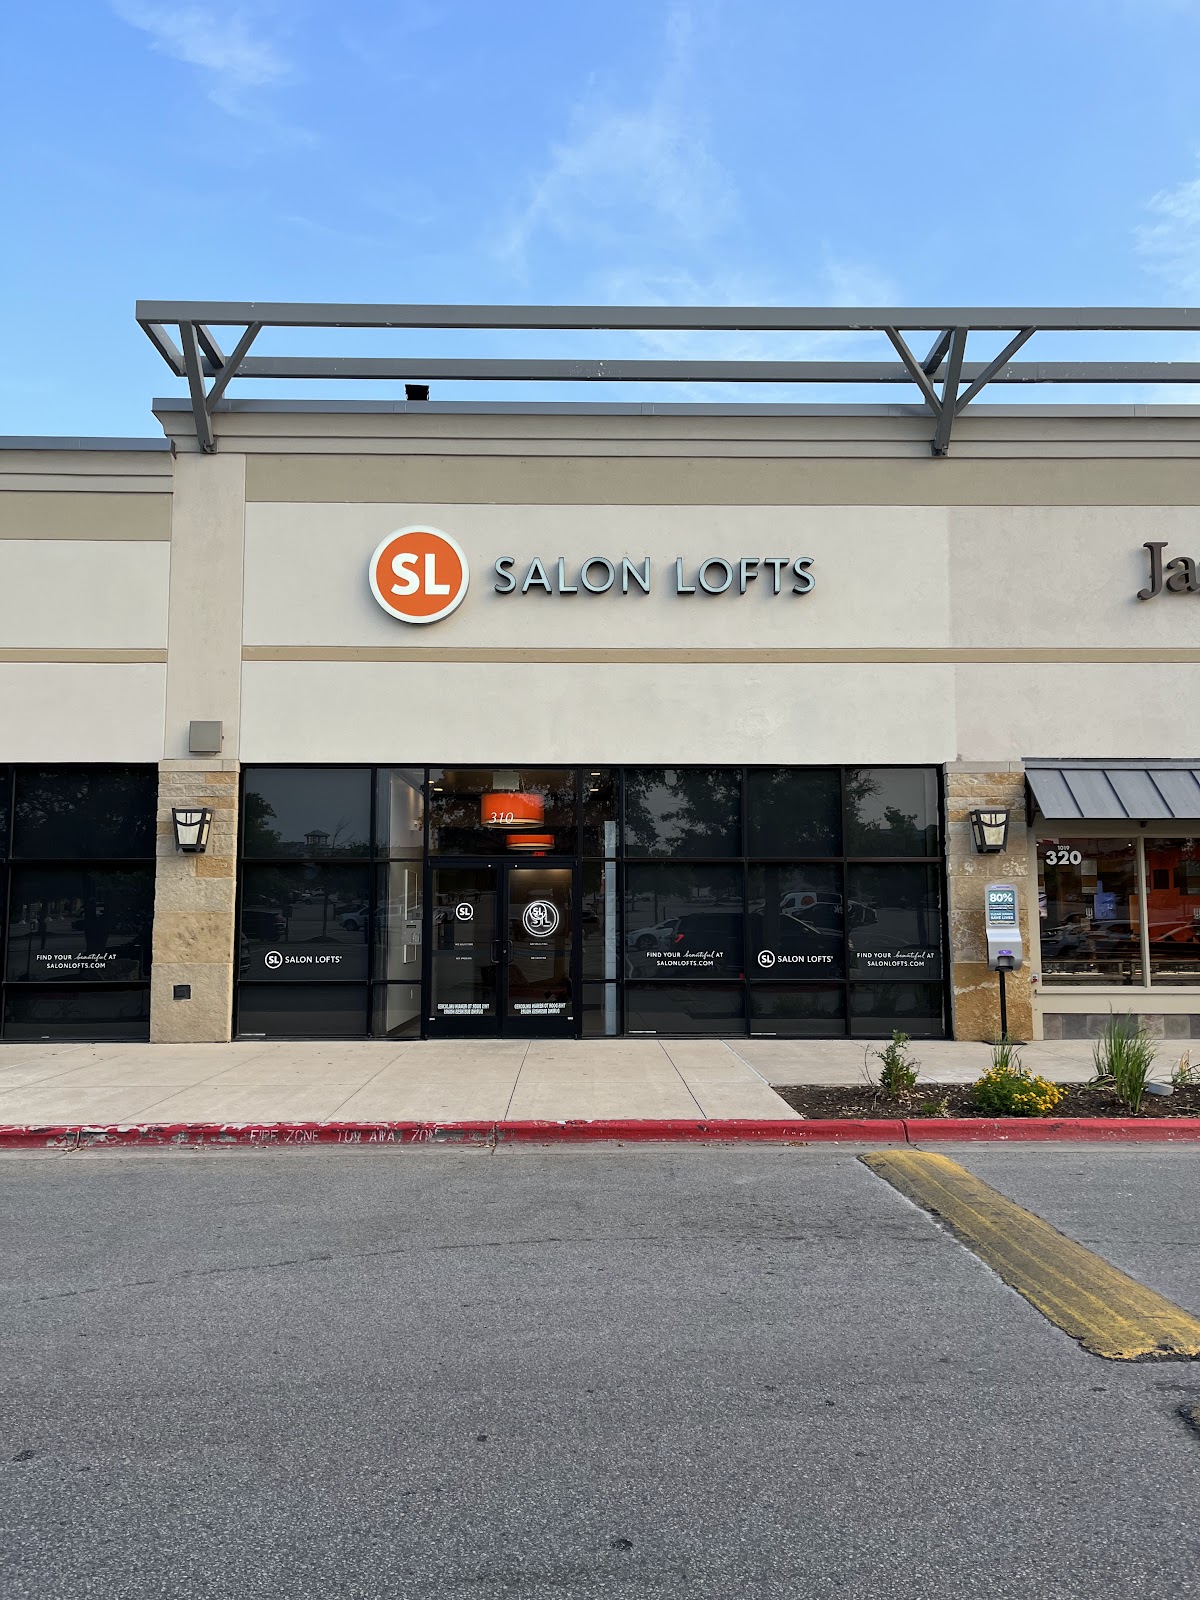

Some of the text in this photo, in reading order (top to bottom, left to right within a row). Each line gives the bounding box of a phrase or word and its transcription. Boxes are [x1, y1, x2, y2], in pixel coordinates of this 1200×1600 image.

[391, 552, 450, 595] SL
[494, 557, 815, 595] SALON LOFTS
[1137, 542, 1200, 600] Ja
[489, 811, 514, 825] 310
[1046, 851, 1081, 865] 320
[989, 893, 1013, 903] 80%
[459, 907, 471, 916] SL
[74, 952, 108, 962] beautiful
[268, 955, 280, 964] SL
[285, 955, 313, 964] SALON
[683, 950, 715, 960] beautiful
[761, 954, 772, 963] SL
[777, 955, 804, 963] SALON
[893, 950, 926, 960] beautiful
[250, 1129, 277, 1142] FIRE
[285, 1129, 320, 1143] ZONE
[411, 1129, 440, 1143] ZON
